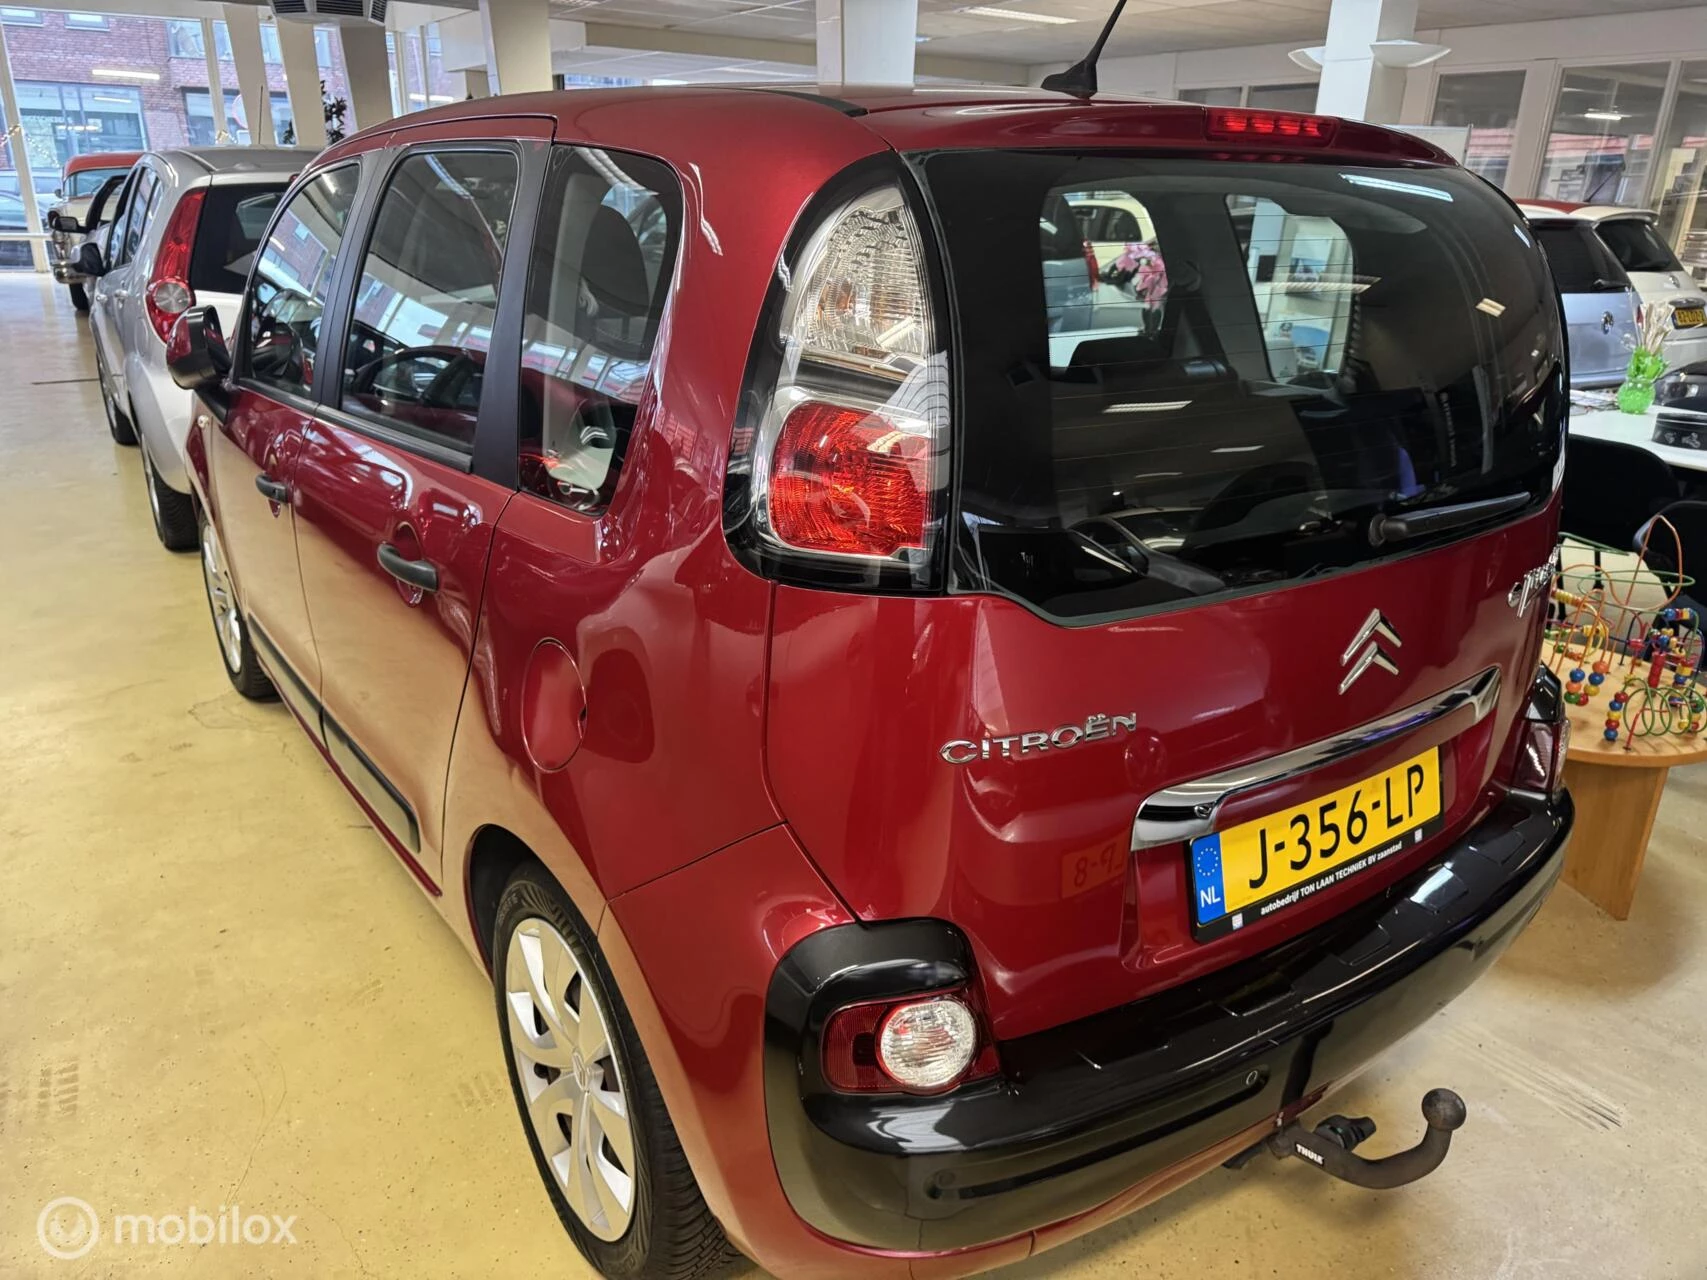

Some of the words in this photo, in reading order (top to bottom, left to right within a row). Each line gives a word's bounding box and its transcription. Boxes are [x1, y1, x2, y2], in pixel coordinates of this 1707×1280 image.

[939, 712, 1137, 764] CITROËN
[1249, 763, 1424, 889] J-356-LP
[1200, 885, 1221, 908] NL
[1260, 889, 1300, 916] autobedrijf
[1300, 883, 1316, 897] TON
[1316, 873, 1335, 890] LAAN
[1335, 859, 1368, 881] TECHNIEK
[1367, 854, 1377, 866] BV
[1377, 840, 1403, 861] zaanstad
[1296, 1143, 1324, 1165] THULE
